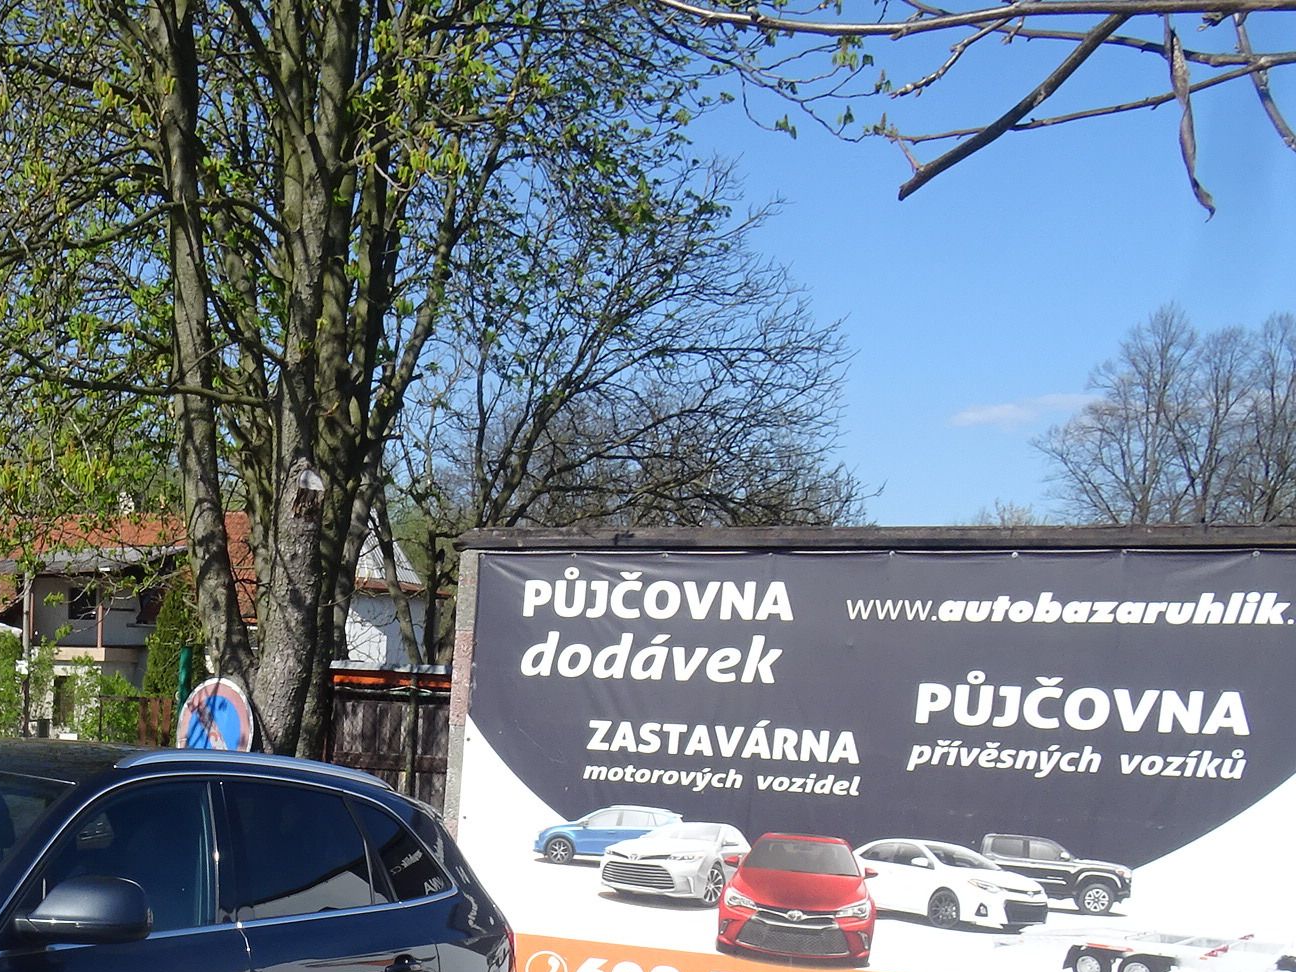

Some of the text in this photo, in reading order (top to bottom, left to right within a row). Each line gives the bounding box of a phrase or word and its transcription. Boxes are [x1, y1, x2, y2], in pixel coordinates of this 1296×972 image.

[522, 566, 794, 621] PŮJČOVNA
[520, 630, 783, 684] dodávek
[914, 670, 1250, 736] PŮJČOVNA
[586, 719, 860, 765] ZASTAVÁRNA
[906, 739, 1247, 779] přívěsných vozíků
[582, 764, 861, 796] motorových vozidel
